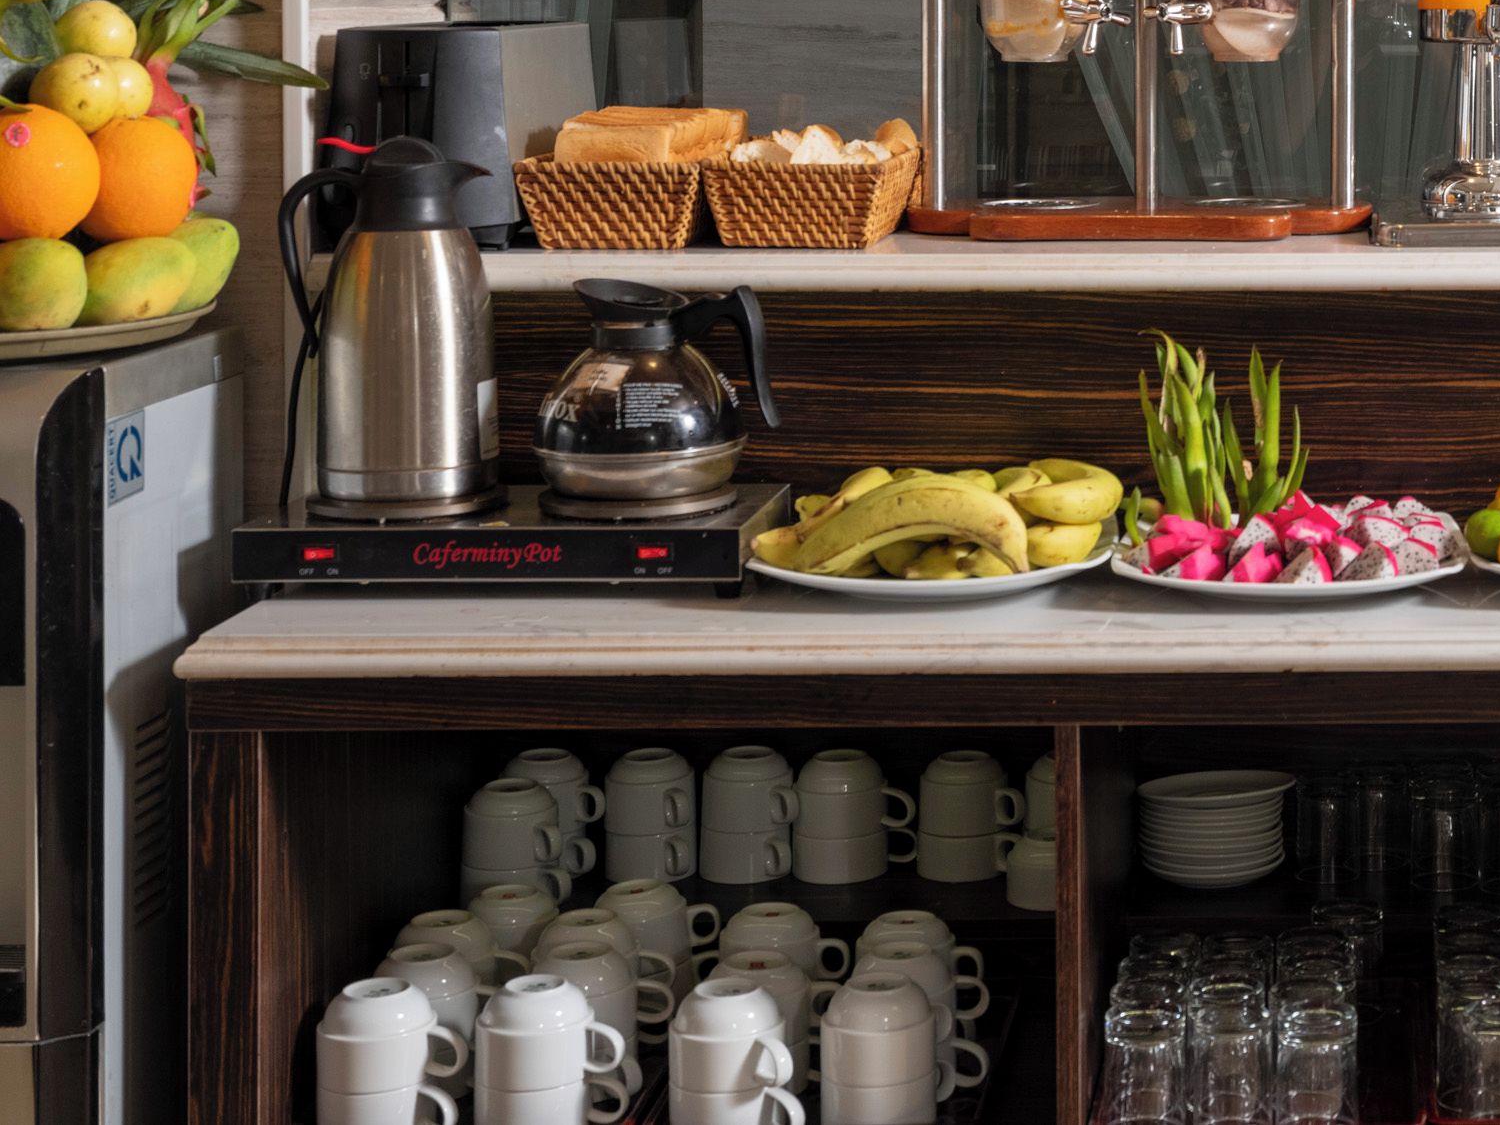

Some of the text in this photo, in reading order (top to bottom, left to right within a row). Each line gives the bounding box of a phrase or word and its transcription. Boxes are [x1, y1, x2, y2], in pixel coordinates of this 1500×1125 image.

[413, 540, 561, 569] CaferminyPot
[299, 568, 339, 576] OFF ON
